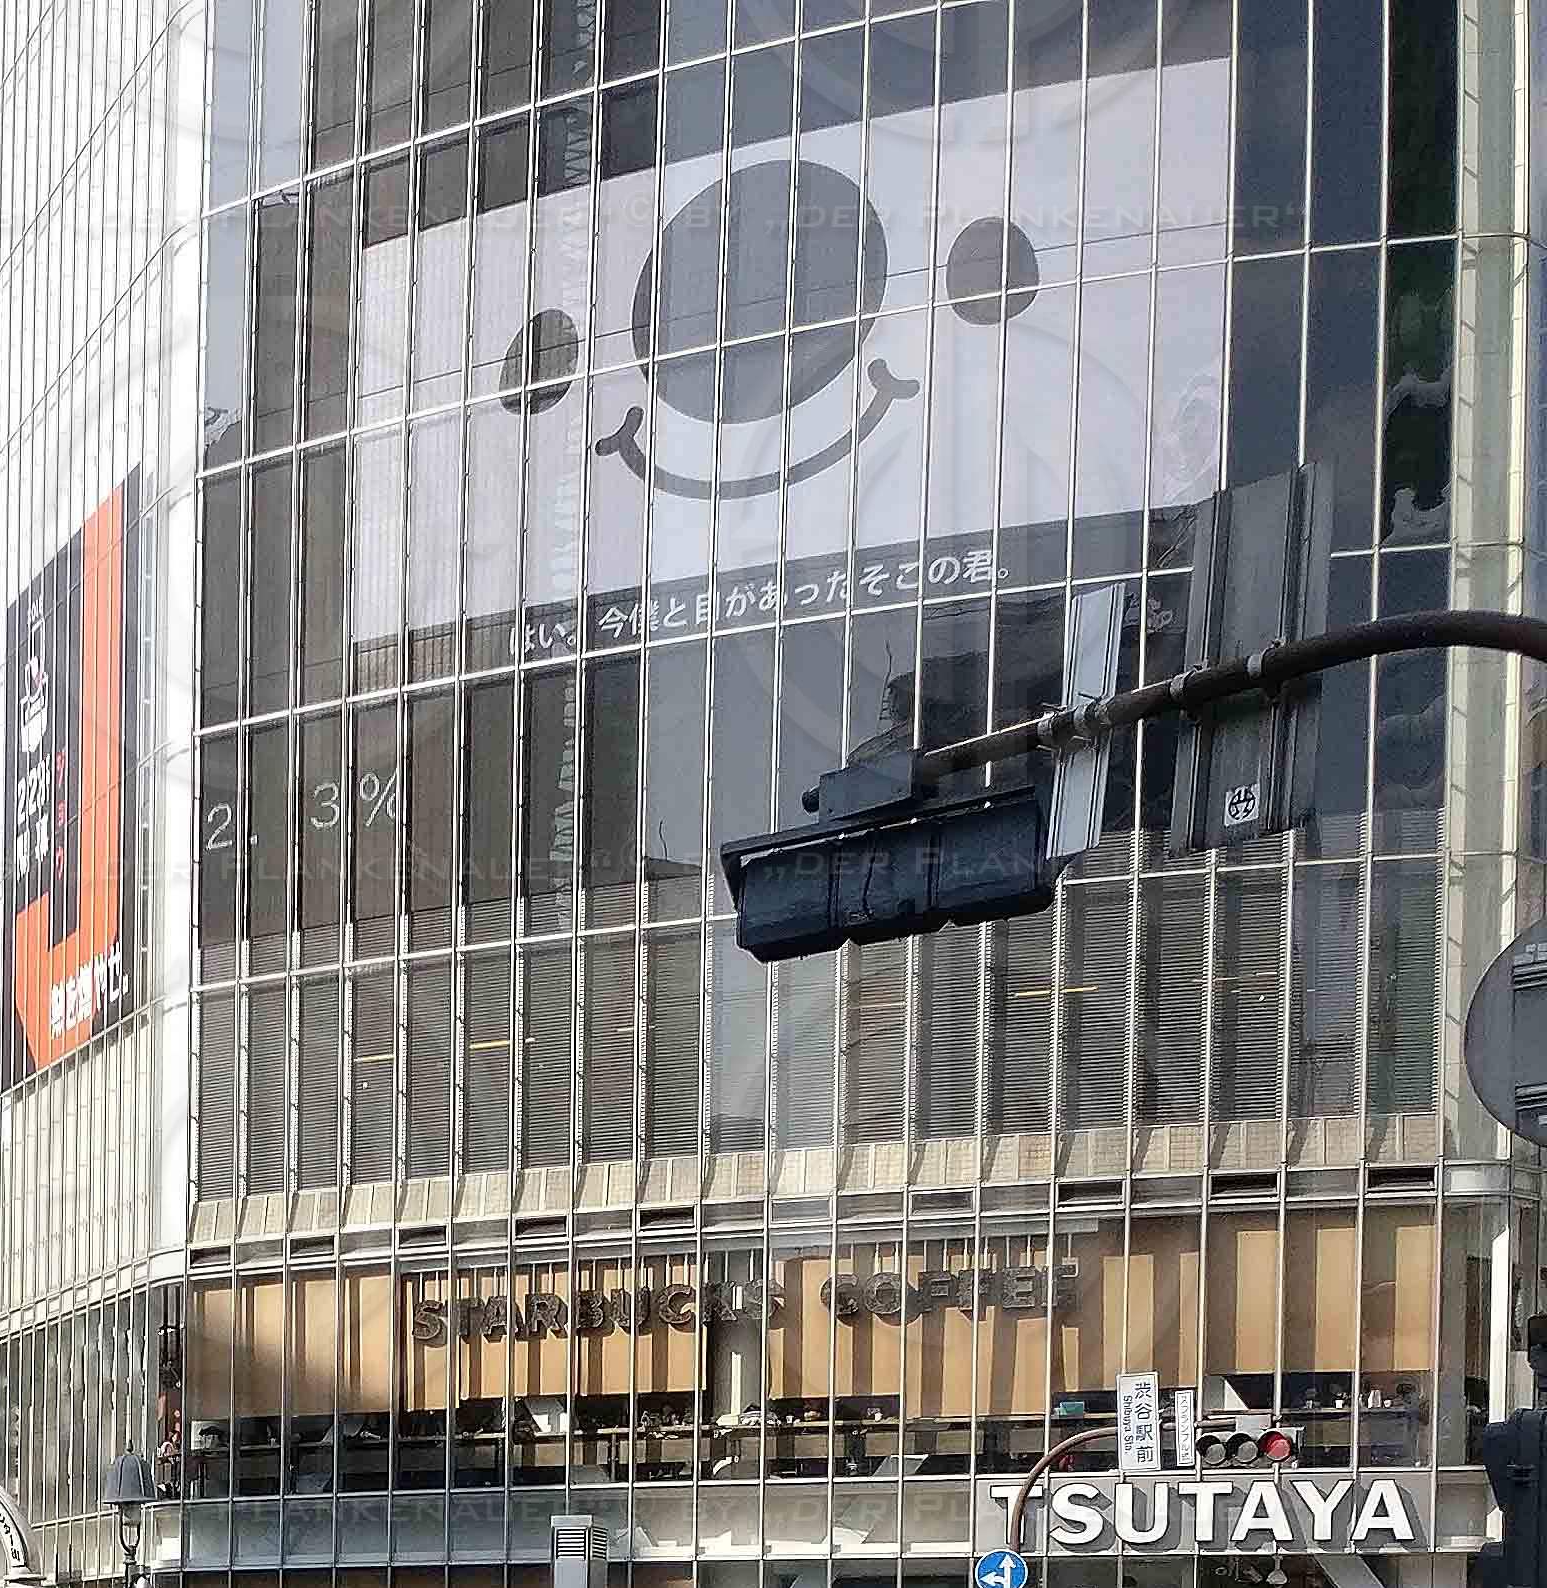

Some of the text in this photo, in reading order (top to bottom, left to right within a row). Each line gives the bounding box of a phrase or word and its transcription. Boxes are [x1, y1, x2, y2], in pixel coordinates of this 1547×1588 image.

[411, 1278, 784, 1346] STARBUCKS
[1134, 1381, 1155, 1464] 渋谷駅前
[988, 1479, 1416, 1545] TSUTAYA
